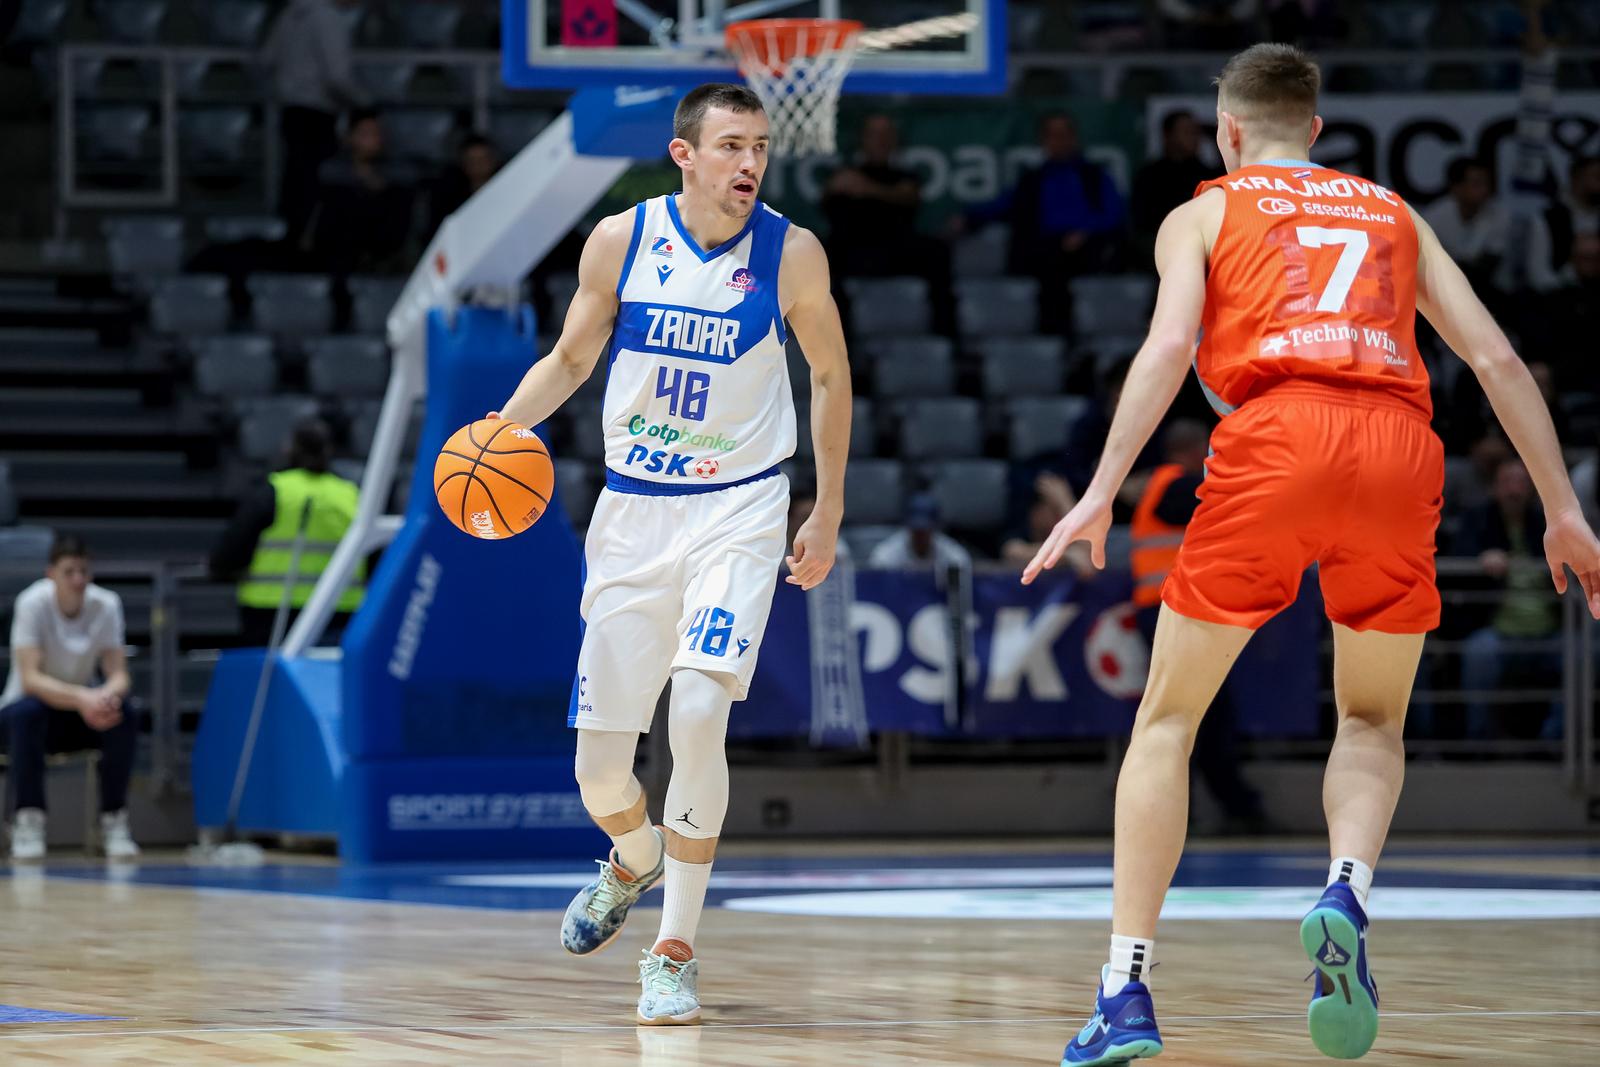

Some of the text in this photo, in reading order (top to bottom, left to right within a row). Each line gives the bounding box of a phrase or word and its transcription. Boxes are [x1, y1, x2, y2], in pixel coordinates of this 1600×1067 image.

[1302, 202, 1366, 213] CROATIA
[1295, 226, 1369, 313] 7
[645, 308, 740, 359] ZADAR
[1288, 324, 1396, 354] Techno Win
[655, 365, 711, 422] 46
[625, 444, 694, 477] PSK
[685, 606, 736, 657] 46
